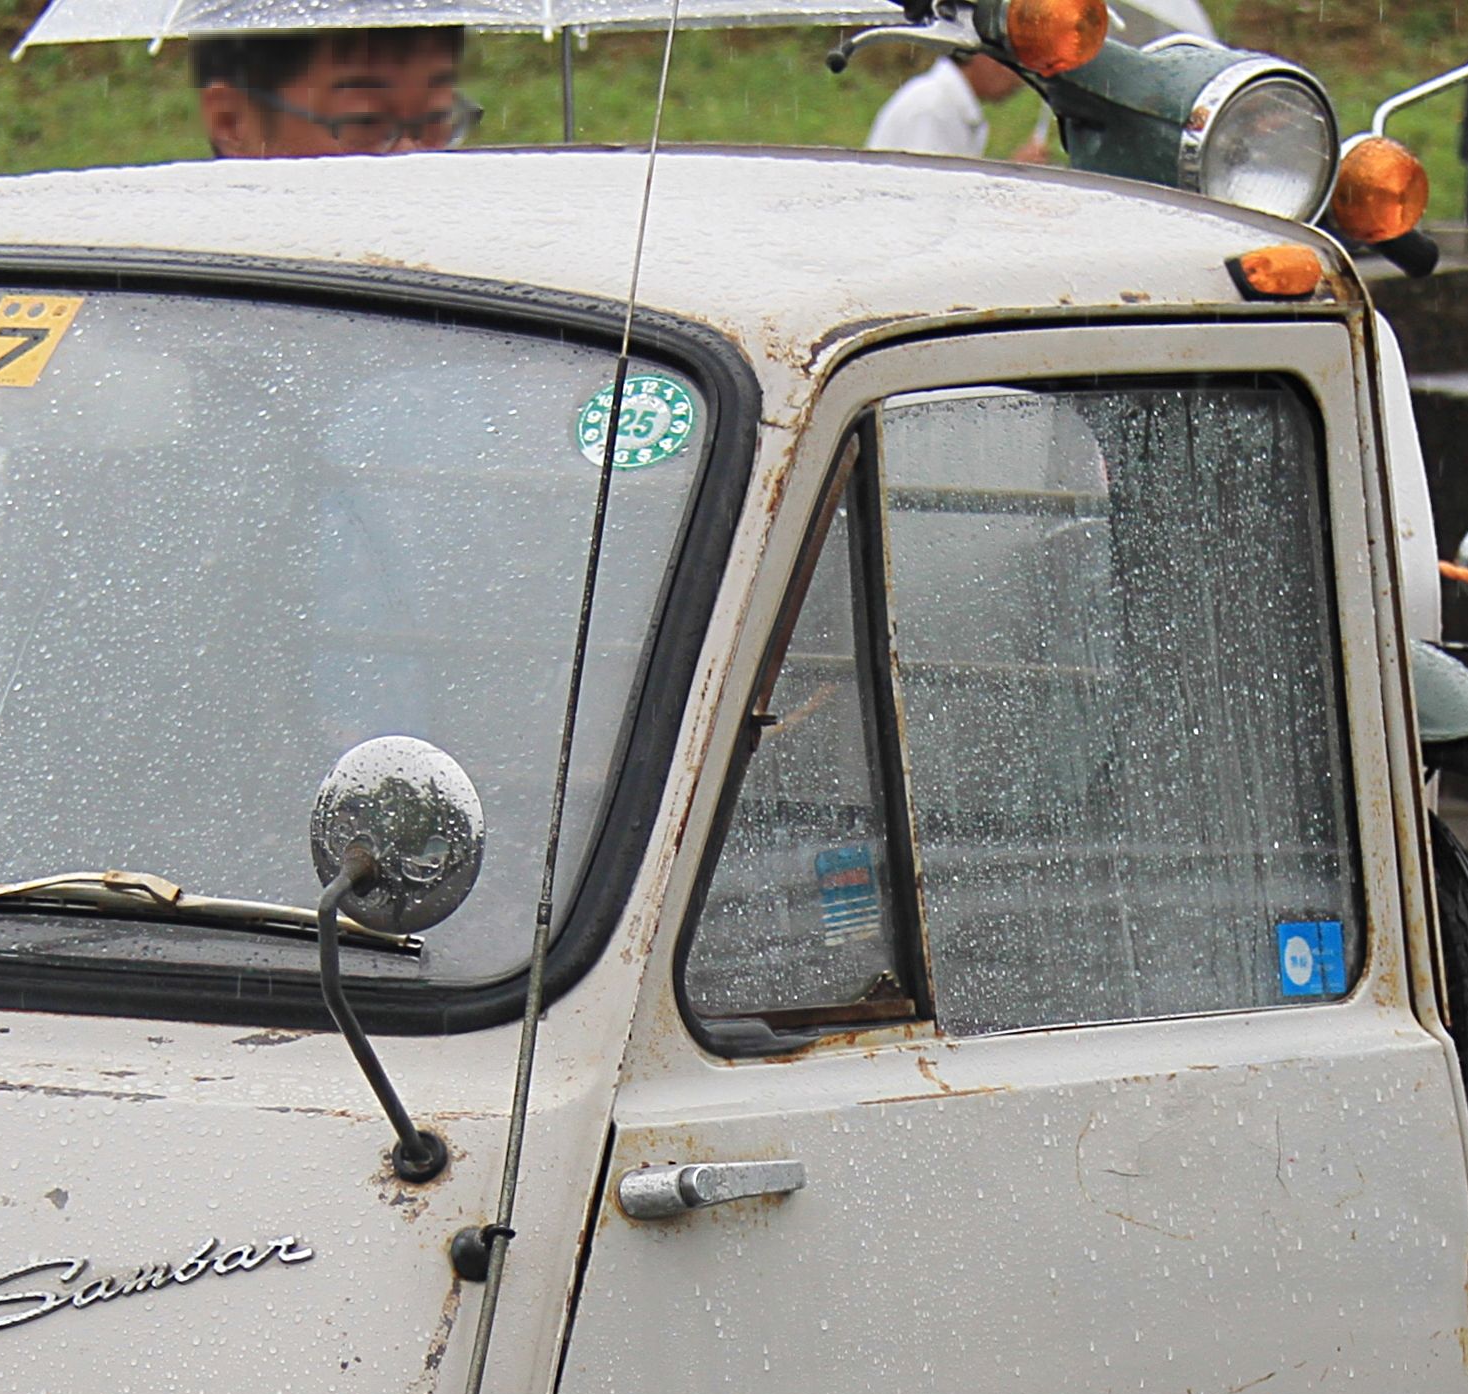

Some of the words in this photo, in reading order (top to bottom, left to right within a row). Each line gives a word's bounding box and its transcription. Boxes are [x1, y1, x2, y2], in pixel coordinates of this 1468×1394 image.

[641, 381, 659, 393] 12
[672, 402, 688, 415] 2
[618, 408, 657, 438] 25
[670, 420, 687, 434] 3
[636, 448, 652, 463] 5
